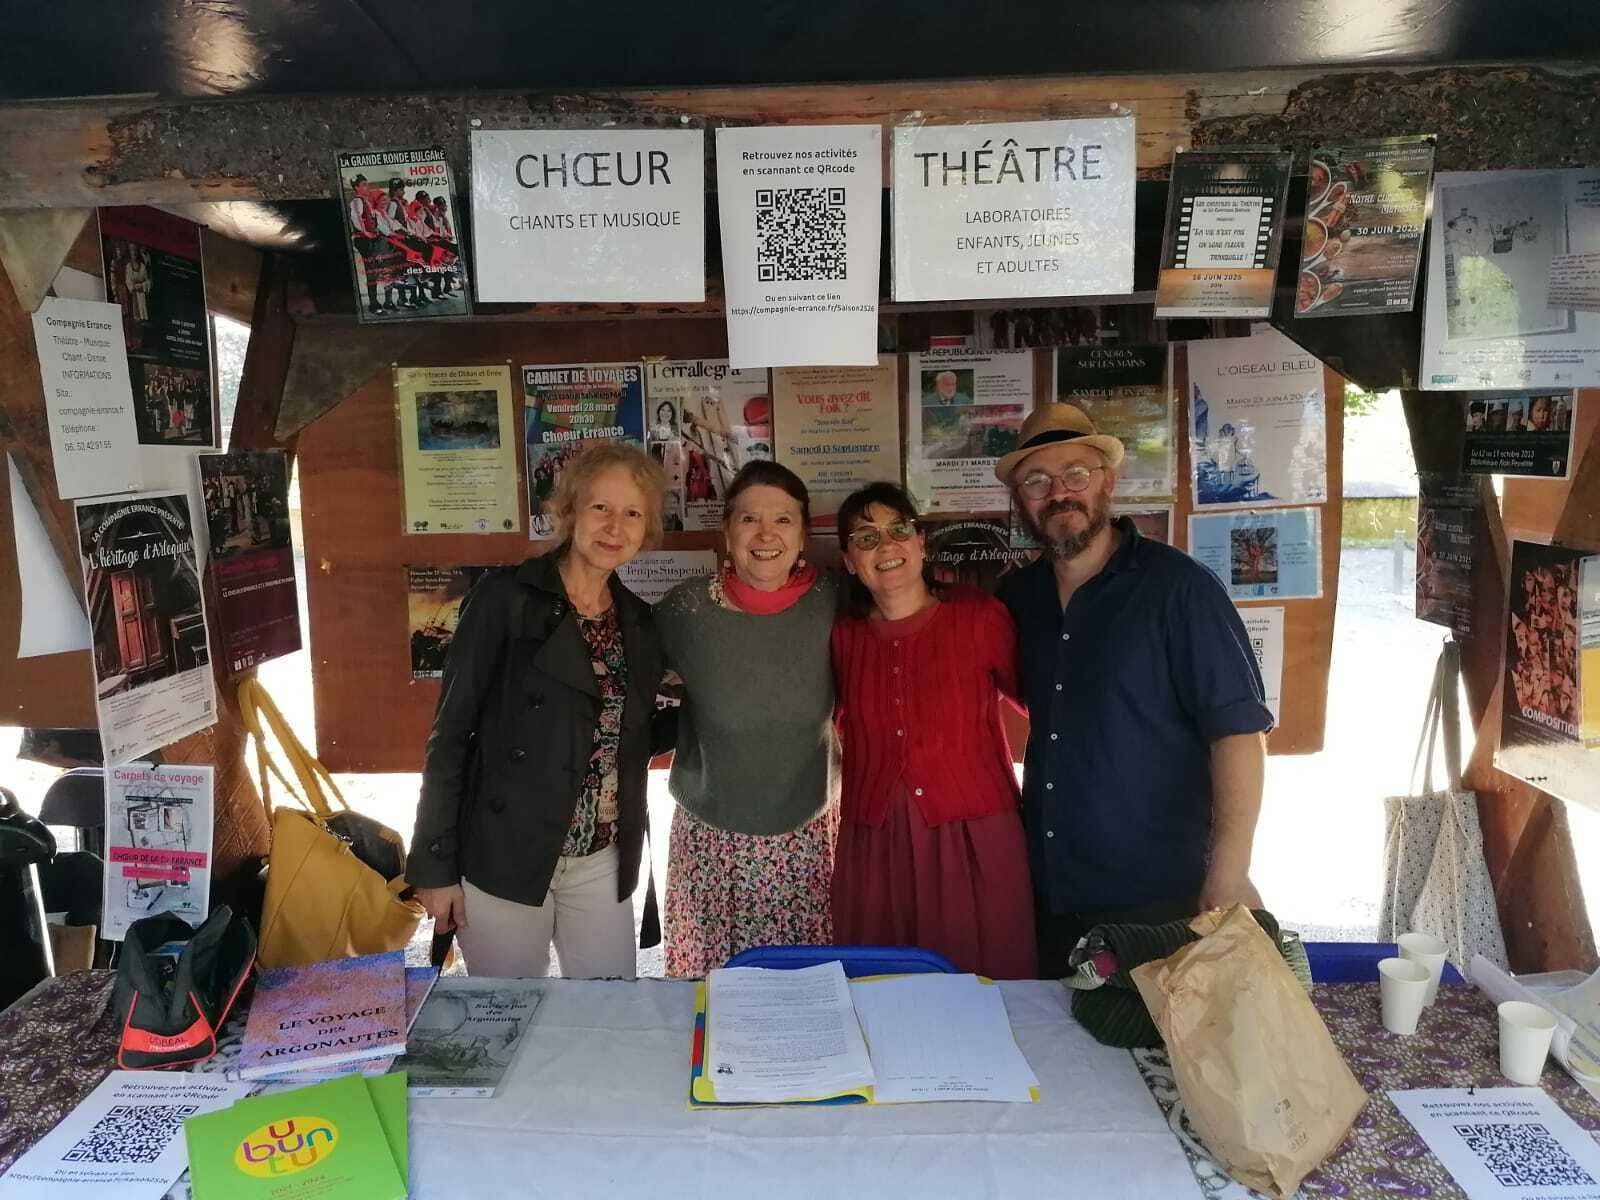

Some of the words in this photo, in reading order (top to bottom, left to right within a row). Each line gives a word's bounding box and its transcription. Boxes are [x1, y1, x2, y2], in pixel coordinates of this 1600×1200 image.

[340, 158, 349, 167] LA
[351, 153, 381, 166] GRANDE
[383, 152, 409, 164] RONDE
[411, 150, 445, 162] BULGARE
[743, 151, 793, 161] Retrouvez
[795, 151, 812, 159] nos
[815, 149, 857, 159] activités
[915, 138, 1102, 187] THÉÂTRE
[410, 165, 444, 176] HORO
[516, 151, 671, 189] CHŒUR
[743, 168, 755, 176] en
[757, 166, 801, 175] scannant
[803, 166, 815, 174] ce
[817, 164, 855, 174] QRcode
[509, 213, 574, 231] CHANTS
[579, 213, 598, 229] ET
[604, 211, 681, 229] MUSIQUE
[966, 207, 1071, 224] LABORATOIRES
[1357, 227, 1368, 236] 30
[1371, 226, 1393, 234] JUIN
[957, 234, 1024, 251] ENFANTS,
[1028, 233, 1080, 248] JEUNES
[407, 266, 423, 274] des
[977, 260, 995, 274] ET
[998, 259, 1059, 273] ADULTES
[788, 293, 815, 301] suivant
[46, 316, 86, 330] Compagnie
[87, 320, 112, 330] Errance
[62, 371, 112, 380] INFORMATIONS
[527, 371, 571, 385] CARNET
[571, 370, 586, 384] DE
[588, 368, 638, 383] VOYAGES
[650, 361, 741, 380] Terrallegra
[1217, 363, 1276, 377] L'OISEAU
[1282, 360, 1316, 372] BLEU
[547, 403, 583, 414] Vendredi
[595, 403, 616, 412] mars
[569, 414, 594, 424] 20h30
[543, 429, 580, 443] Choeur
[583, 425, 625, 440] Errance
[91, 532, 101, 543] LA
[99, 507, 131, 533] COMPAGNIE
[131, 504, 157, 514] ERRANCE
[144, 540, 191, 560] d'Arlequin
[970, 548, 1025, 564] d'Arlequin
[627, 566, 658, 578] Temps
[660, 564, 712, 577] Suspendu
[114, 770, 151, 780] Carnets
[168, 775, 205, 785] voyage
[279, 1019, 303, 1031] LE
[307, 1006, 386, 1025] VOYAGE
[318, 1025, 346, 1036] DES
[259, 1028, 399, 1059] ARGONAUTES
